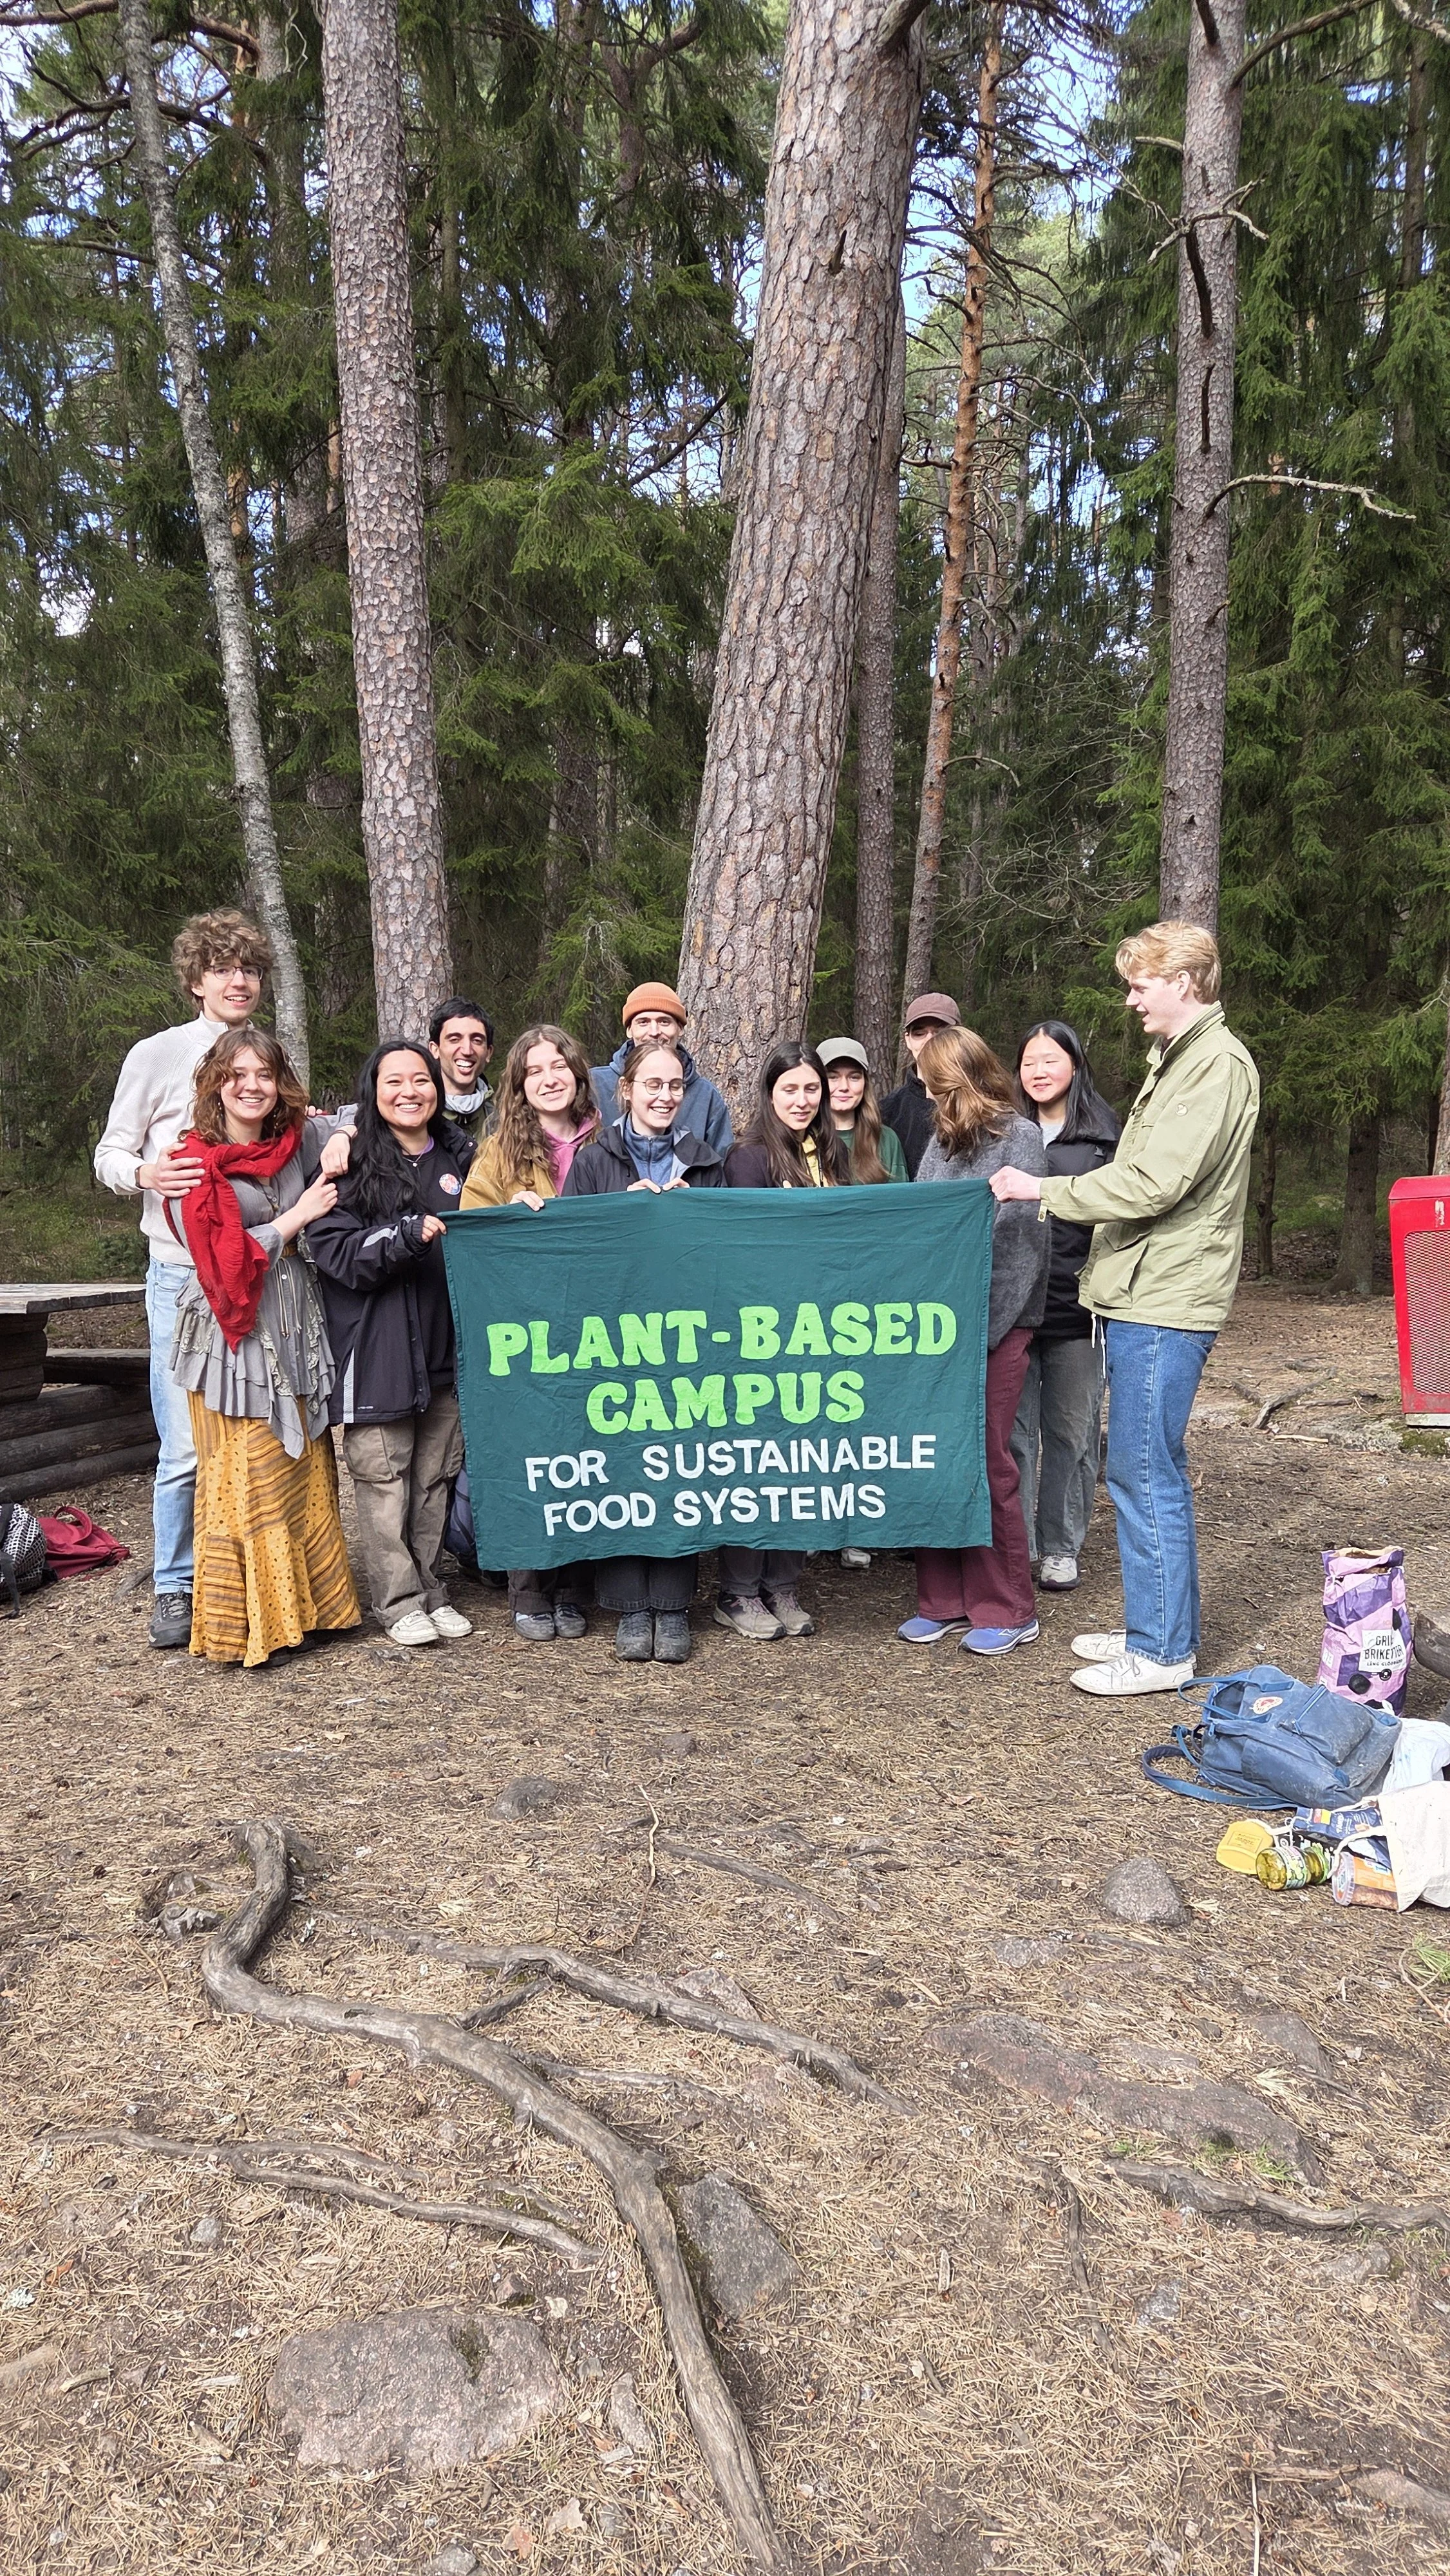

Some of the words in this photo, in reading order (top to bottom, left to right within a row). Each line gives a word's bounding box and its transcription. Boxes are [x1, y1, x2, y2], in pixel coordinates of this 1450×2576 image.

[487, 1302, 957, 1376] PLANT-BASED
[587, 1370, 865, 1434] CAMPUS
[525, 1450, 610, 1492] FOR
[643, 1435, 937, 1481] SUSTAINABLE
[544, 1492, 656, 1536] FOOD
[673, 1482, 886, 1526] SYSTEMS
[1364, 1644, 1404, 1660] BRIKETTER
